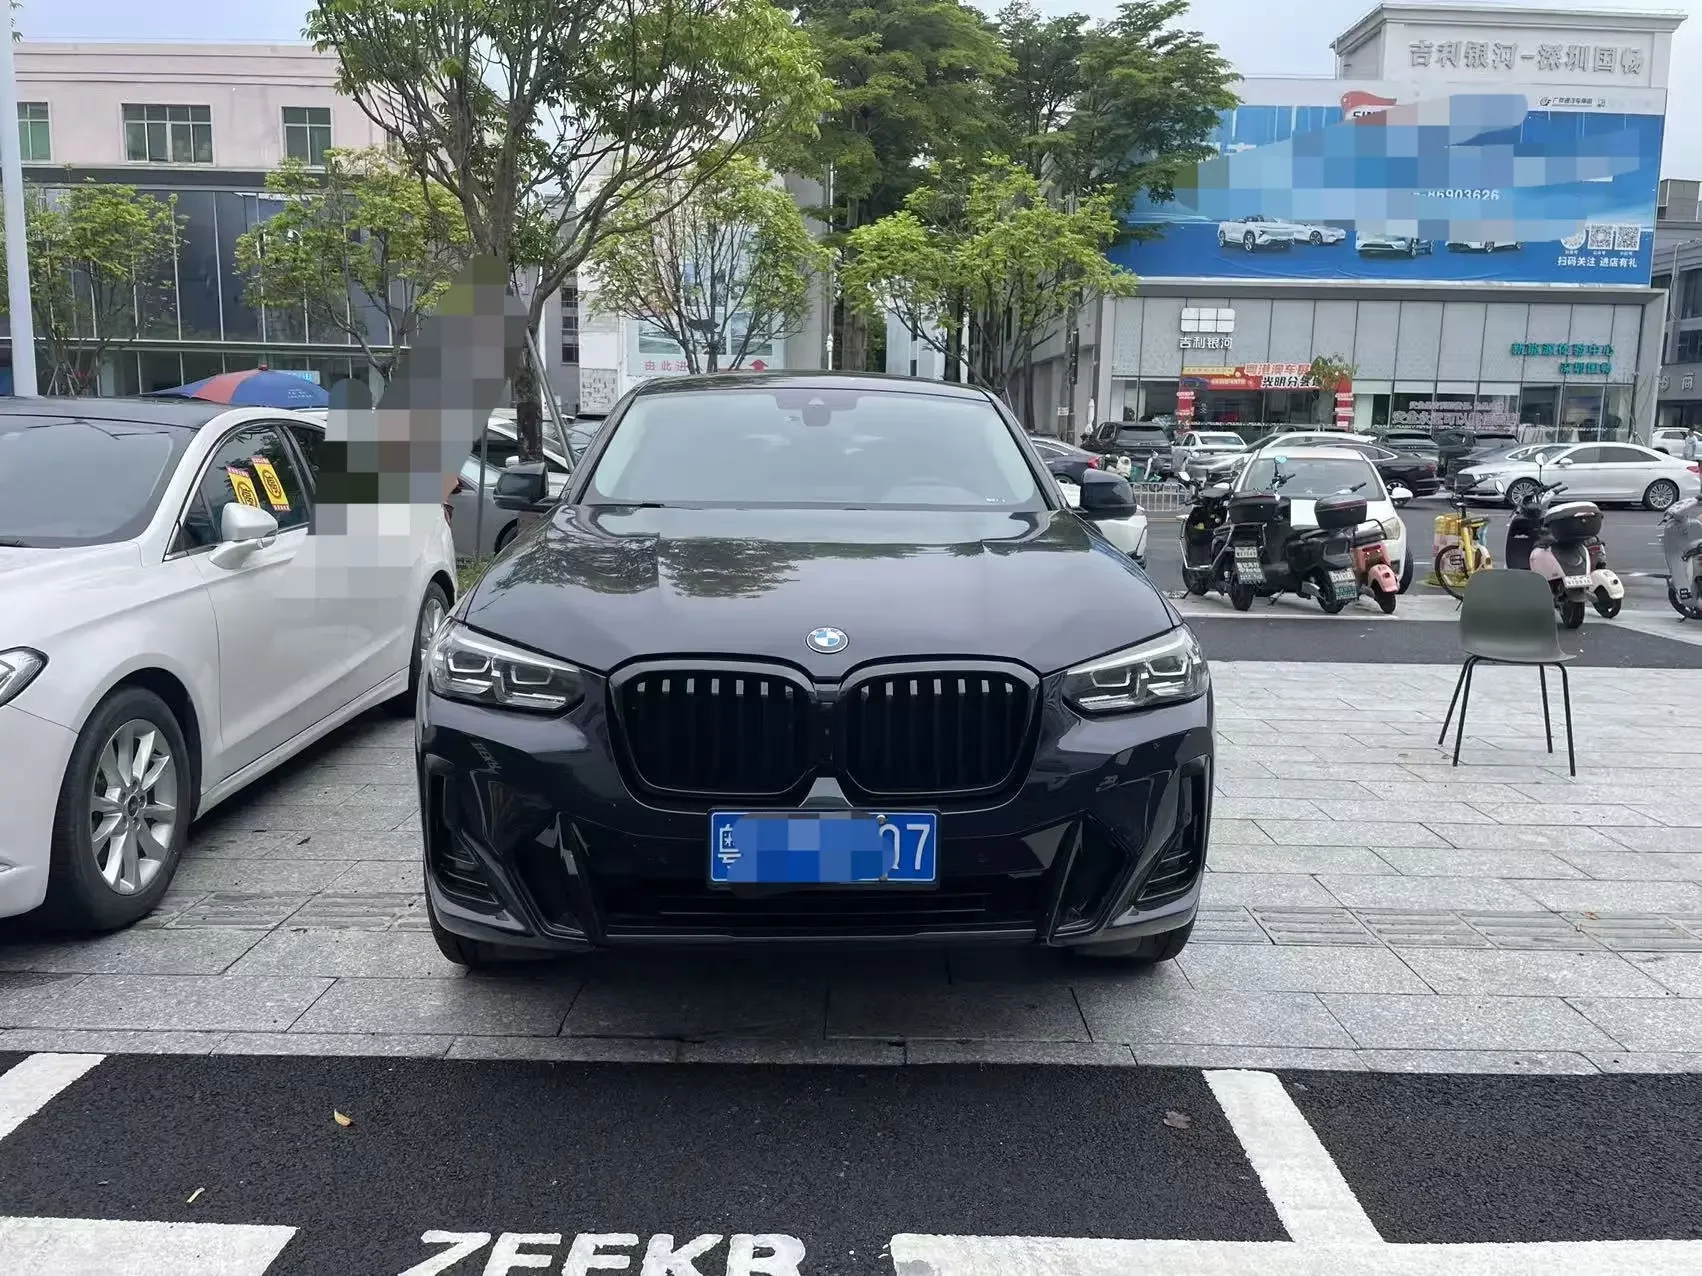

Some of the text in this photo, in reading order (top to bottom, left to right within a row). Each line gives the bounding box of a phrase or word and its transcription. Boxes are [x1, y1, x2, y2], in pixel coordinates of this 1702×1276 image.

[1557, 256, 1638, 268] 扫码关注 进店有礼
[1179, 336, 1233, 350] 吉利银河
